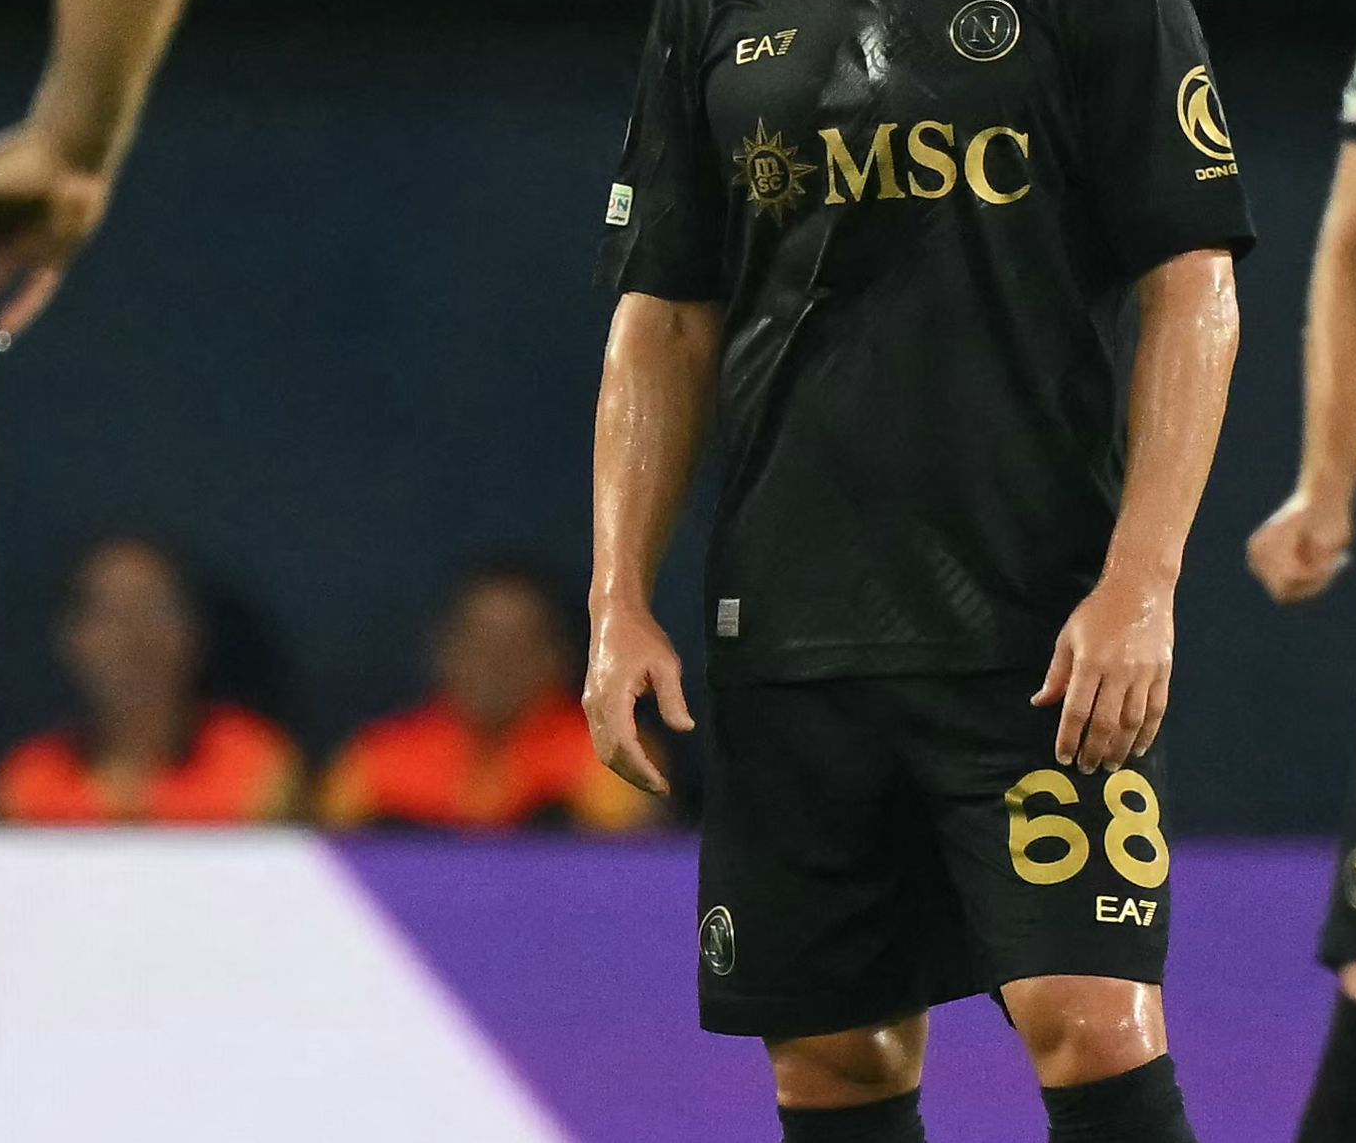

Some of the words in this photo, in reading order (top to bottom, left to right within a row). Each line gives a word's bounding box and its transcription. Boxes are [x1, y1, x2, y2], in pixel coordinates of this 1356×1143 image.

[735, 28, 797, 65] EA7
[818, 121, 1030, 205] MSC
[1004, 769, 1170, 889] 68
[1096, 896, 1157, 926] EA7
